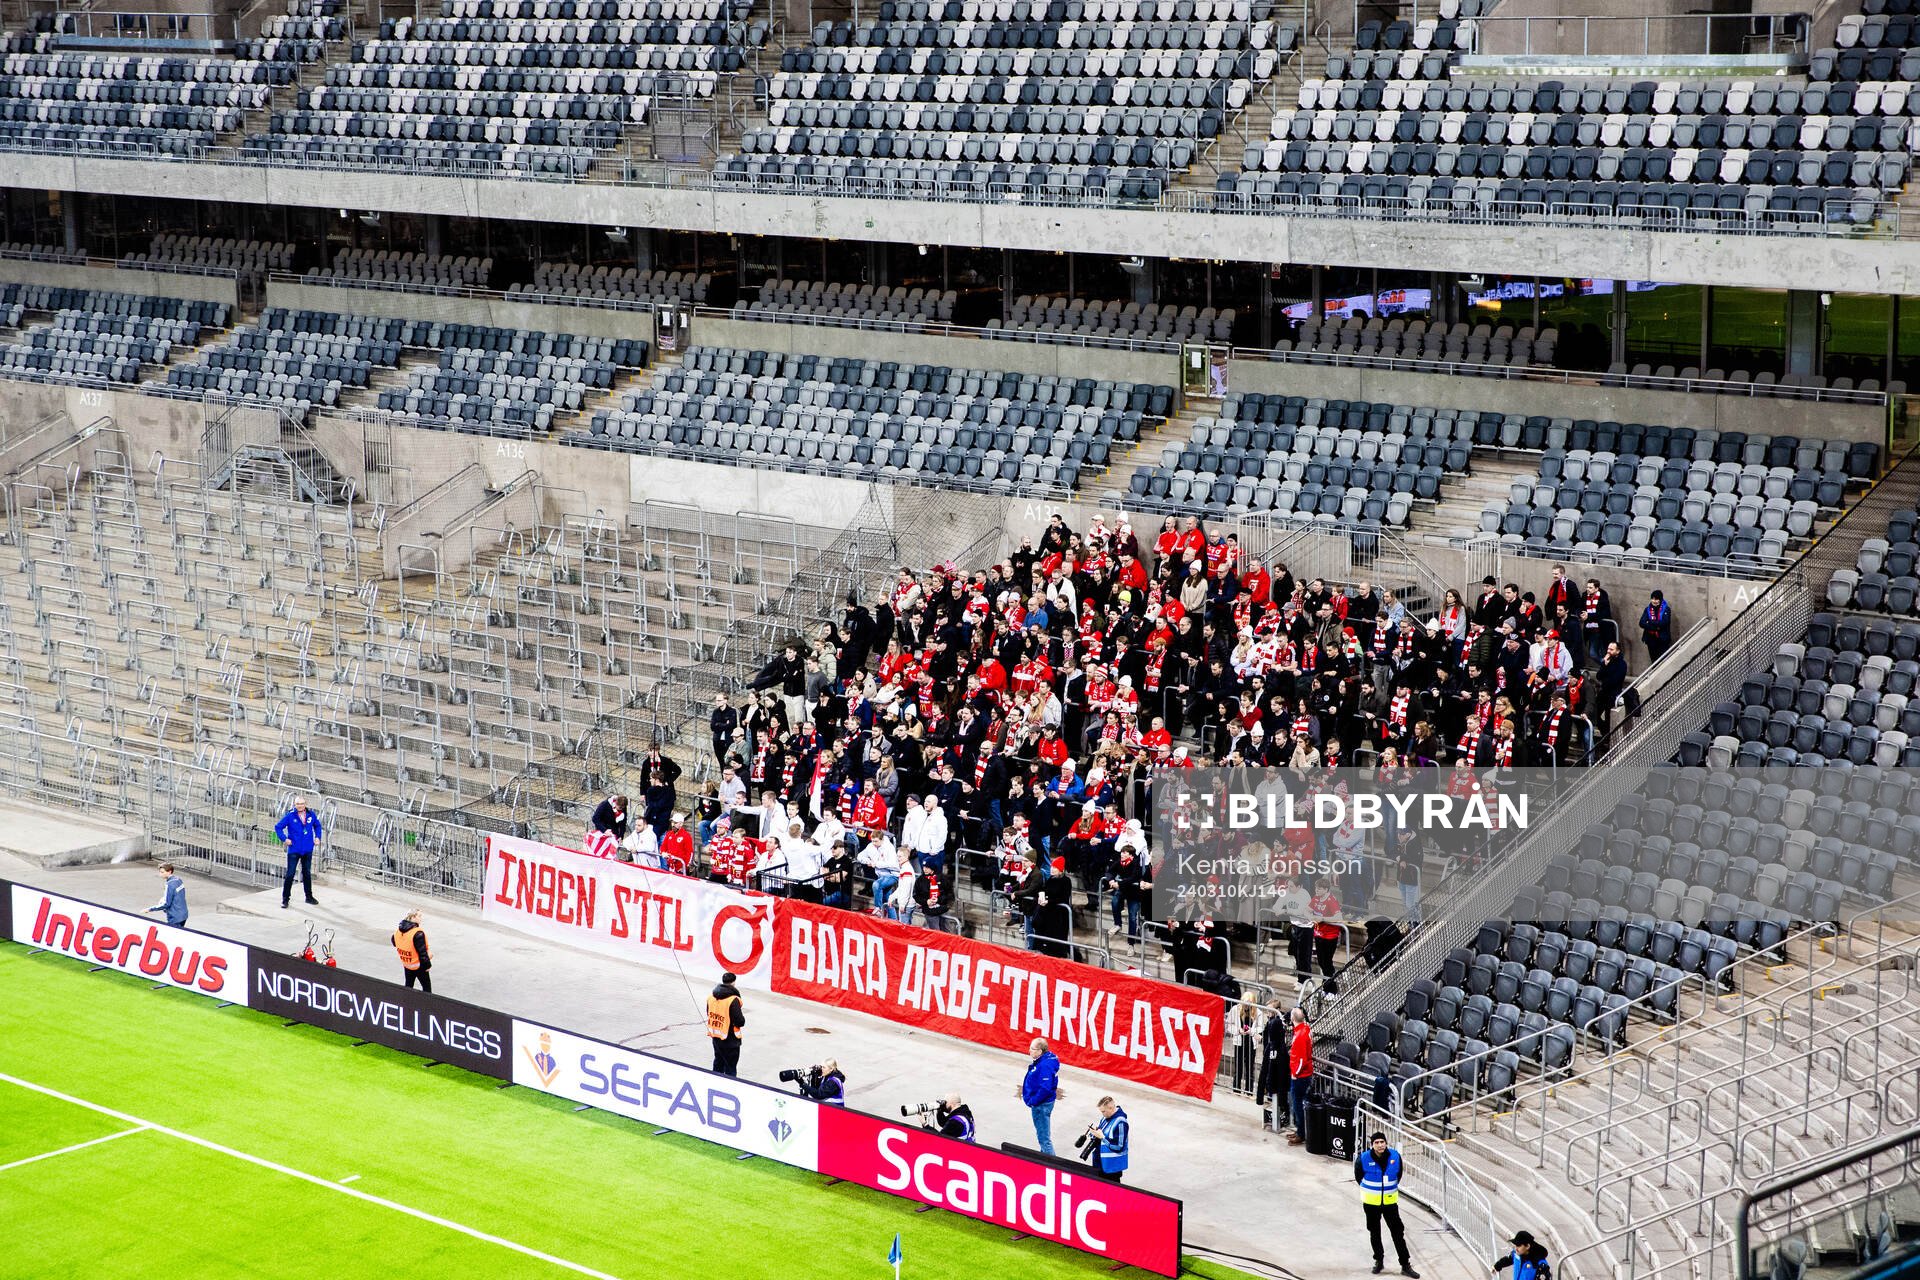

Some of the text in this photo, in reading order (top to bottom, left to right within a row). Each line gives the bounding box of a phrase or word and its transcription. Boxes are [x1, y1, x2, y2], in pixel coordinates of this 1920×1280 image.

[79, 391, 103, 407] A137
[496, 441, 526, 460] A136
[32, 896, 228, 993] Interbus
[610, 884, 694, 952] STIL
[257, 968, 502, 1060] NORDICWELLNESS
[789, 917, 1210, 1074] BARA ARBETARKLASS
[579, 1053, 742, 1134] SEFAB
[876, 1128, 1107, 1251] Scandic
